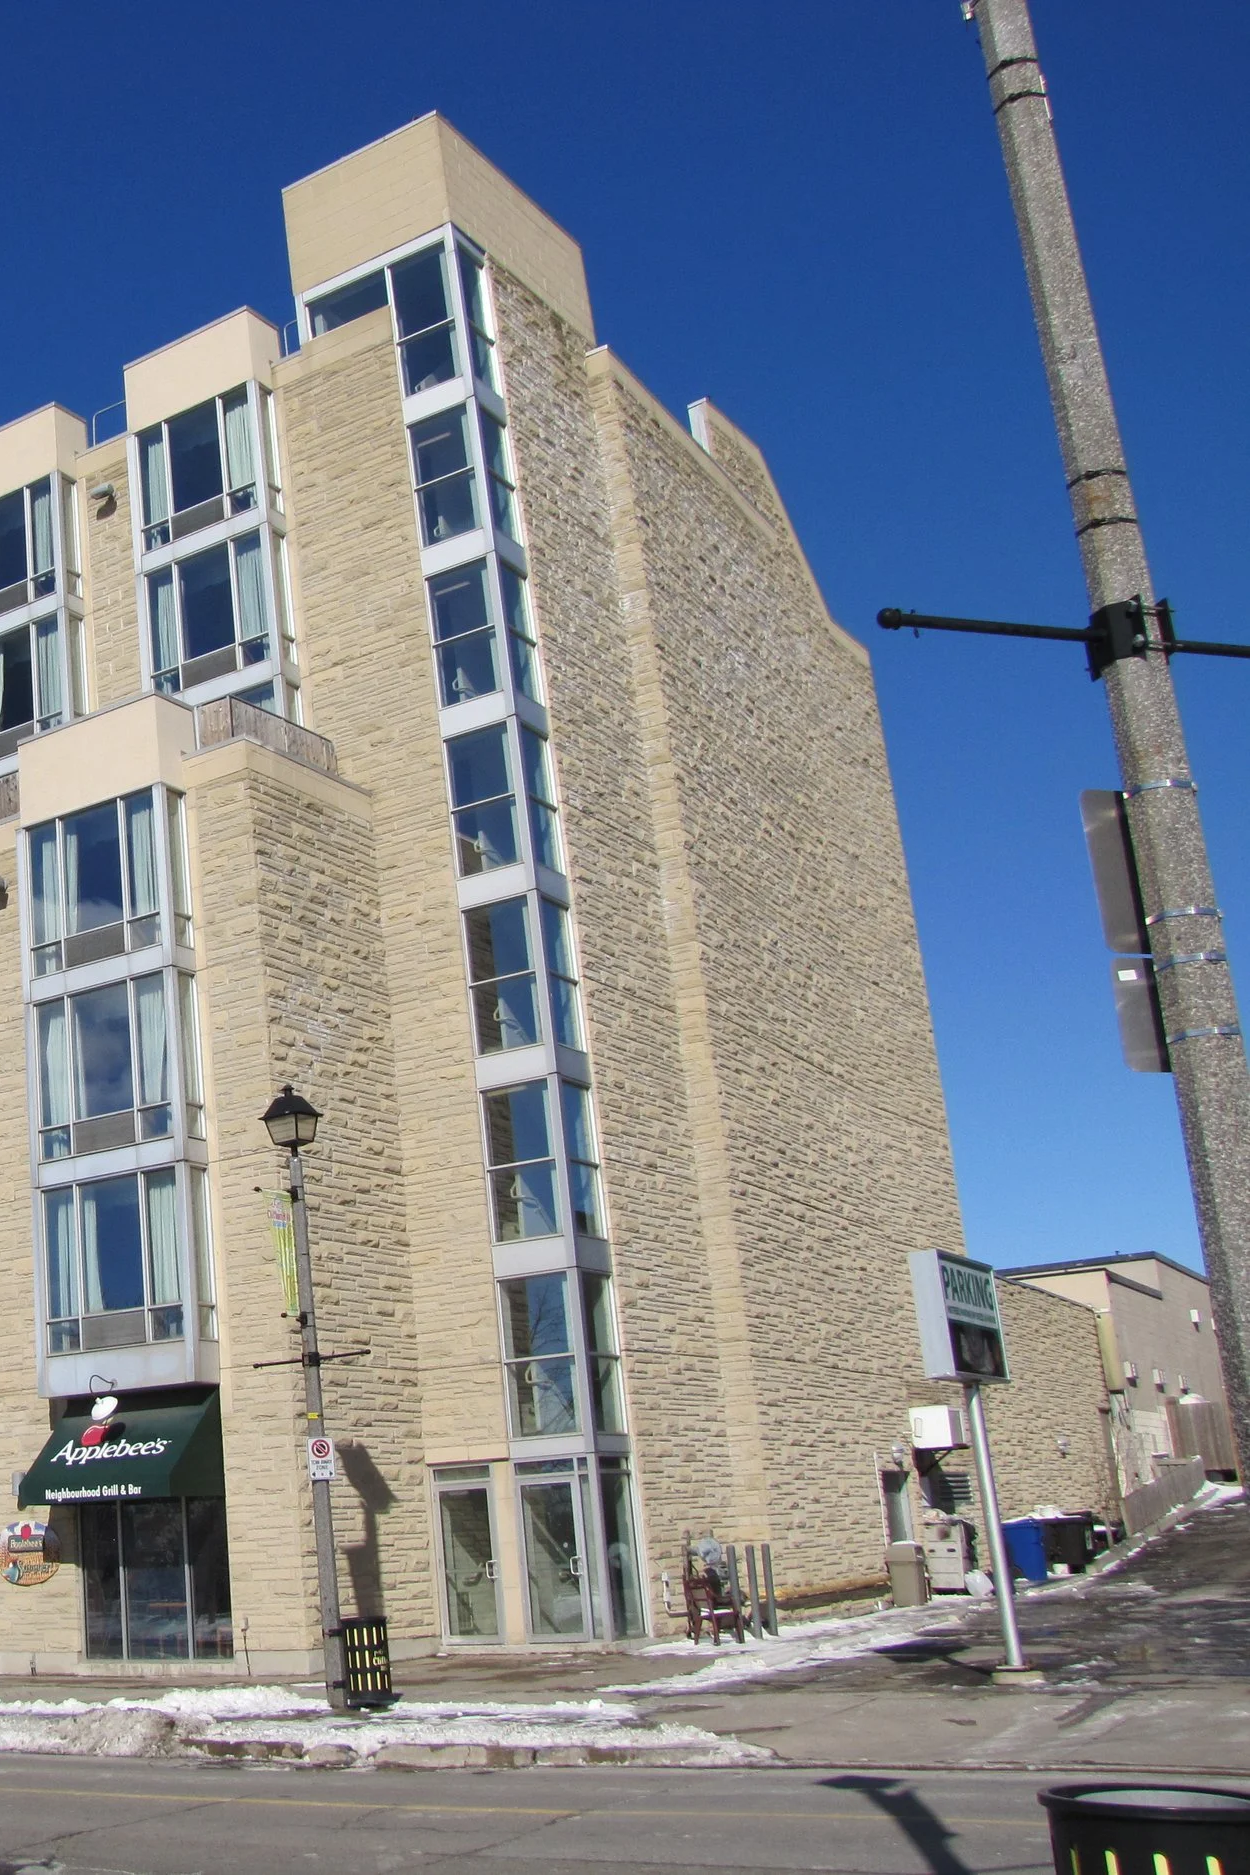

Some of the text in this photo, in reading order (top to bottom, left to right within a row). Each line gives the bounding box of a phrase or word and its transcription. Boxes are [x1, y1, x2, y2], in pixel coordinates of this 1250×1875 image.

[941, 1265, 994, 1311] PARKING
[50, 1438, 168, 1466] Applebee's
[45, 1484, 141, 1502] Neighbourhood Grill & Bar
